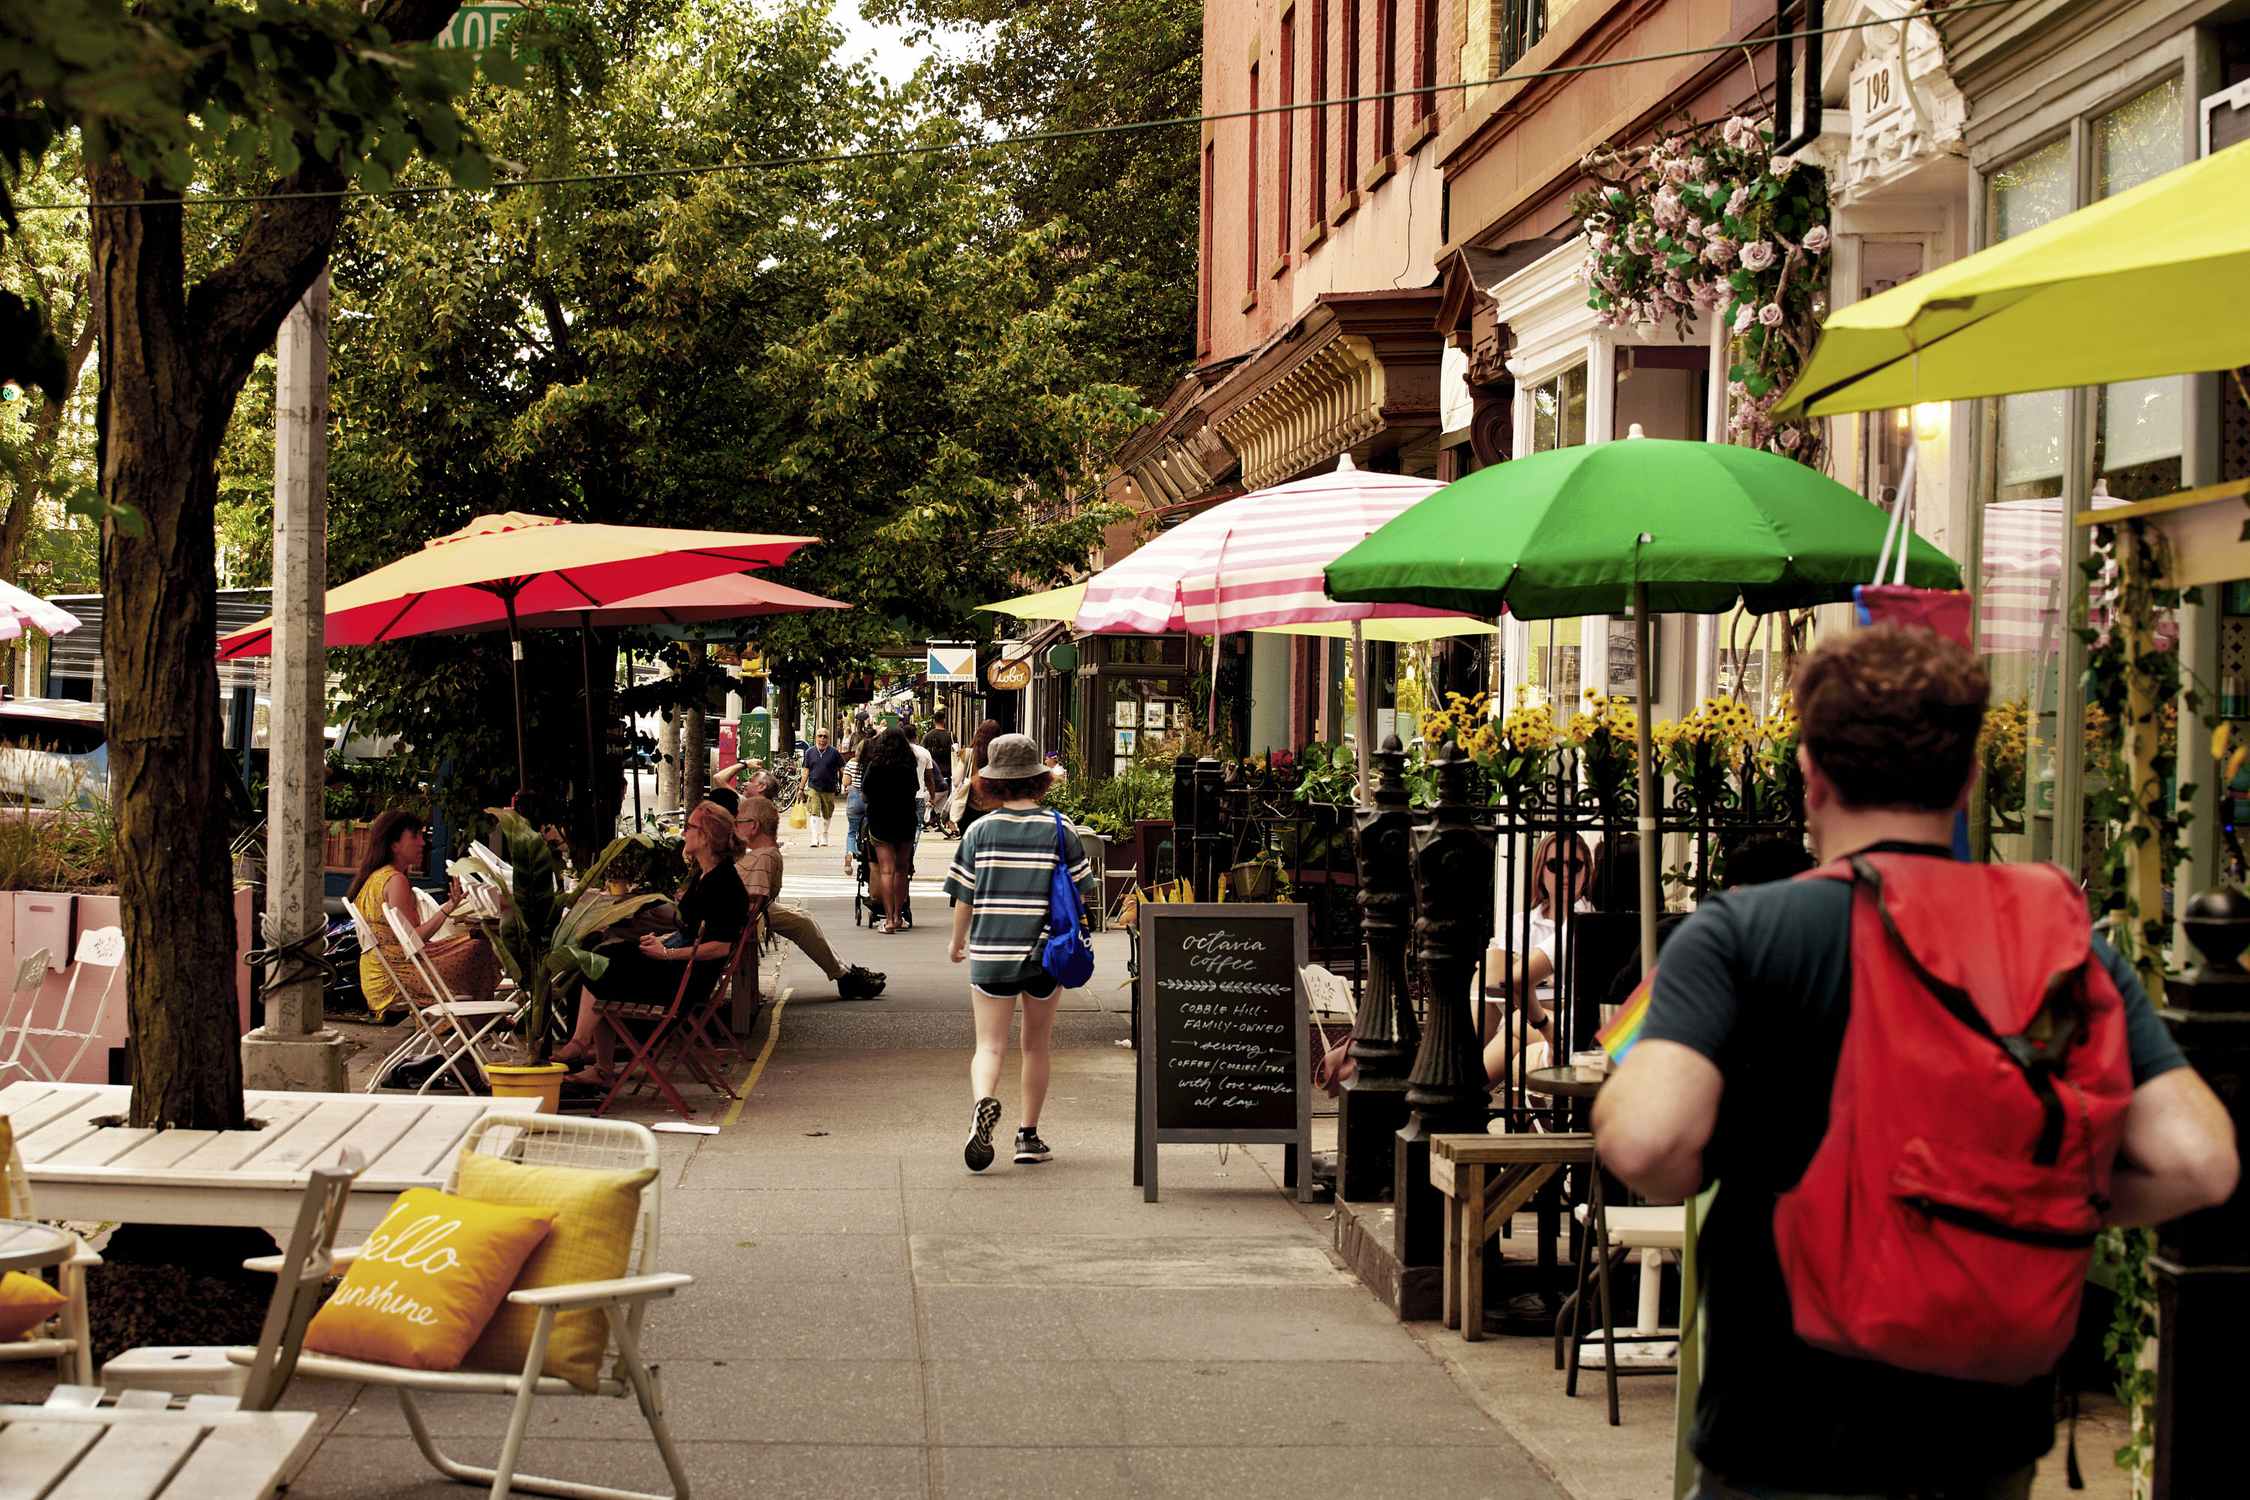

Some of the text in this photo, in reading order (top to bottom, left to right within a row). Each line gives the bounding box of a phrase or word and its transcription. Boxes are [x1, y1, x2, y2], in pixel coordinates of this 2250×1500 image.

[1865, 68, 1889, 113] 198
[1200, 1041, 1267, 1059] serving
[1178, 1077, 1211, 1093] with
[1194, 1096, 1218, 1108] all
[333, 1278, 438, 1325] unshine
